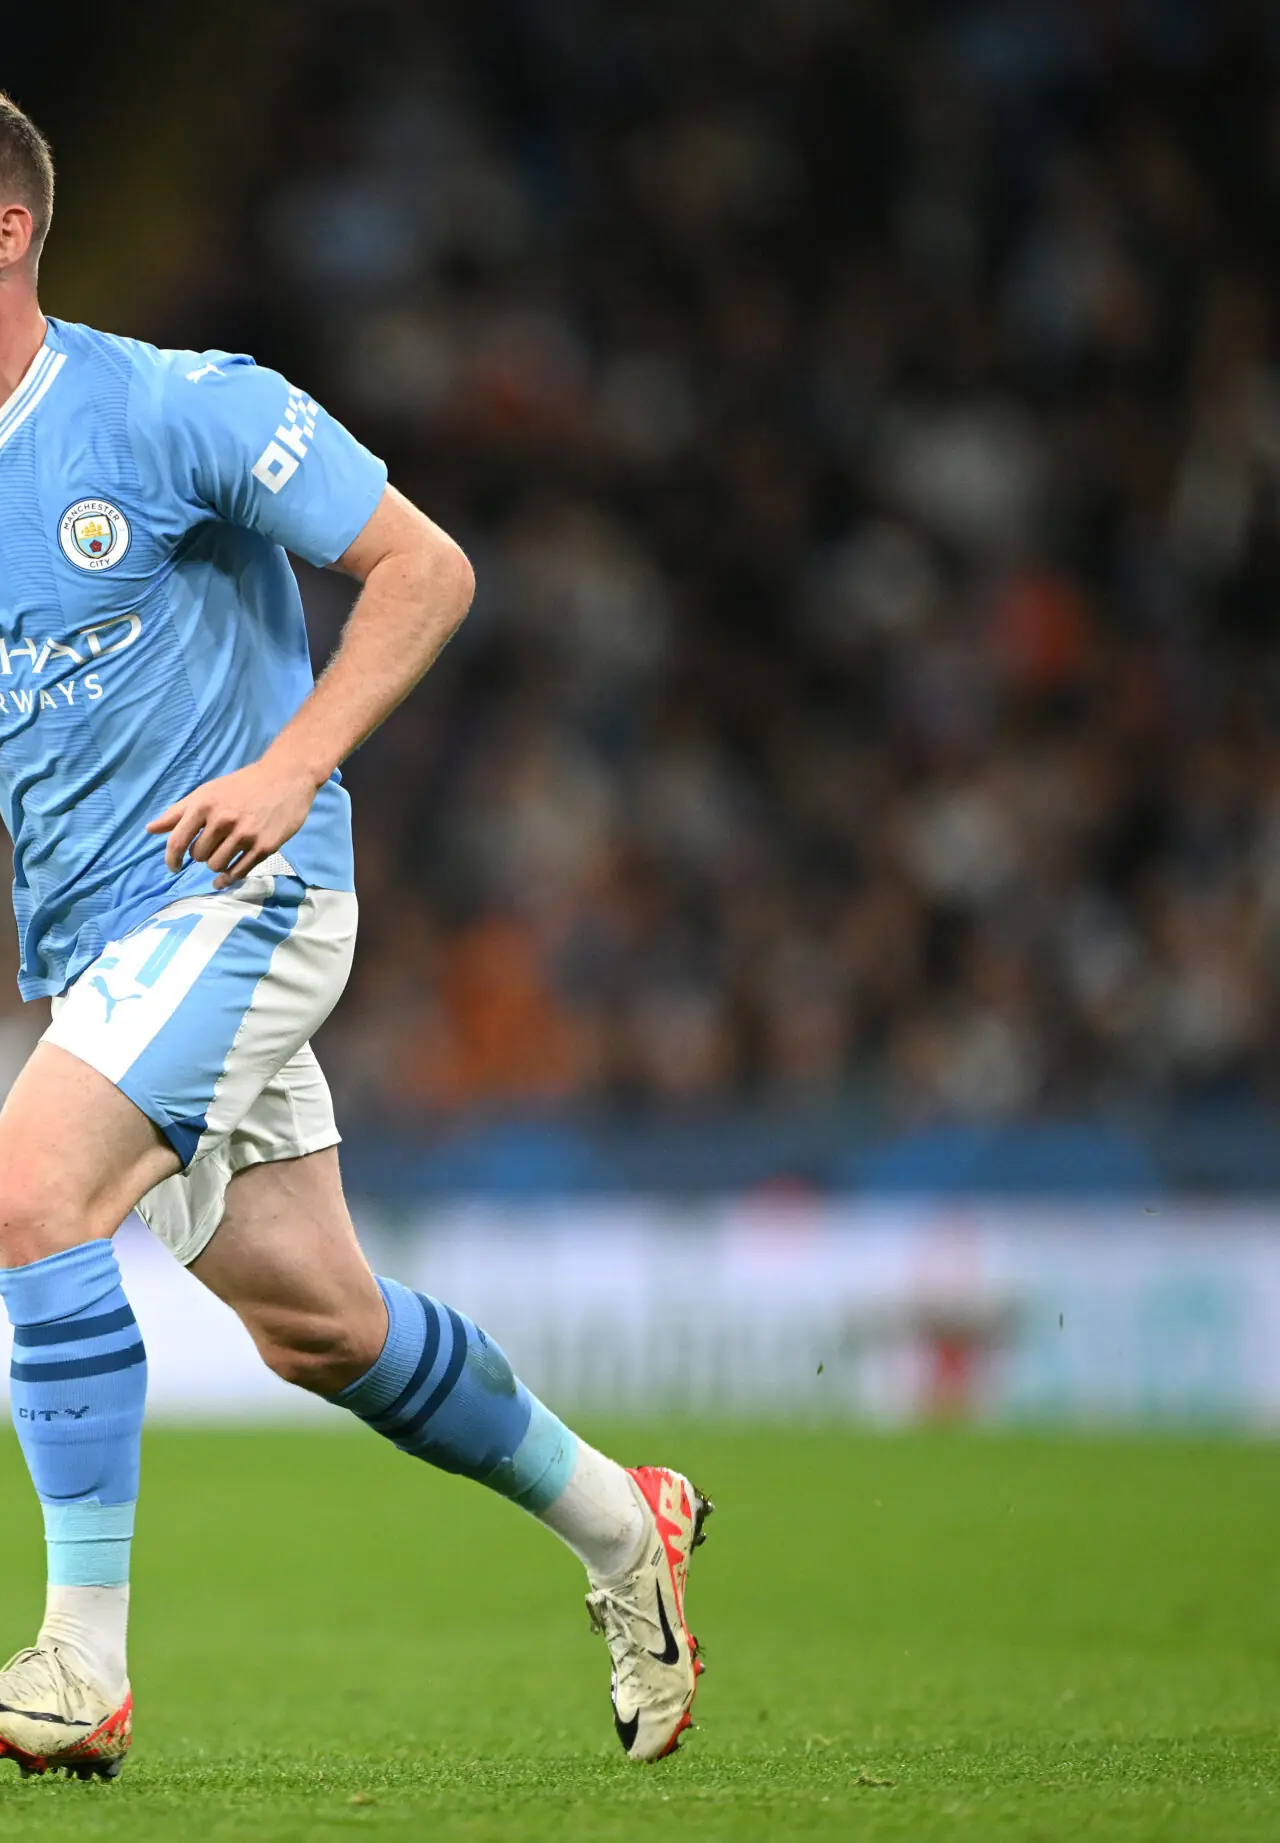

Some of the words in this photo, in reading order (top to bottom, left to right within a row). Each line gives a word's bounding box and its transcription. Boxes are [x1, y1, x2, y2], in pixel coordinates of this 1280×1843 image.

[251, 385, 319, 494] OKX
[63, 502, 120, 531] MANCHESTER
[89, 558, 110, 569] CITY
[19, 1404, 90, 1422] CITY
